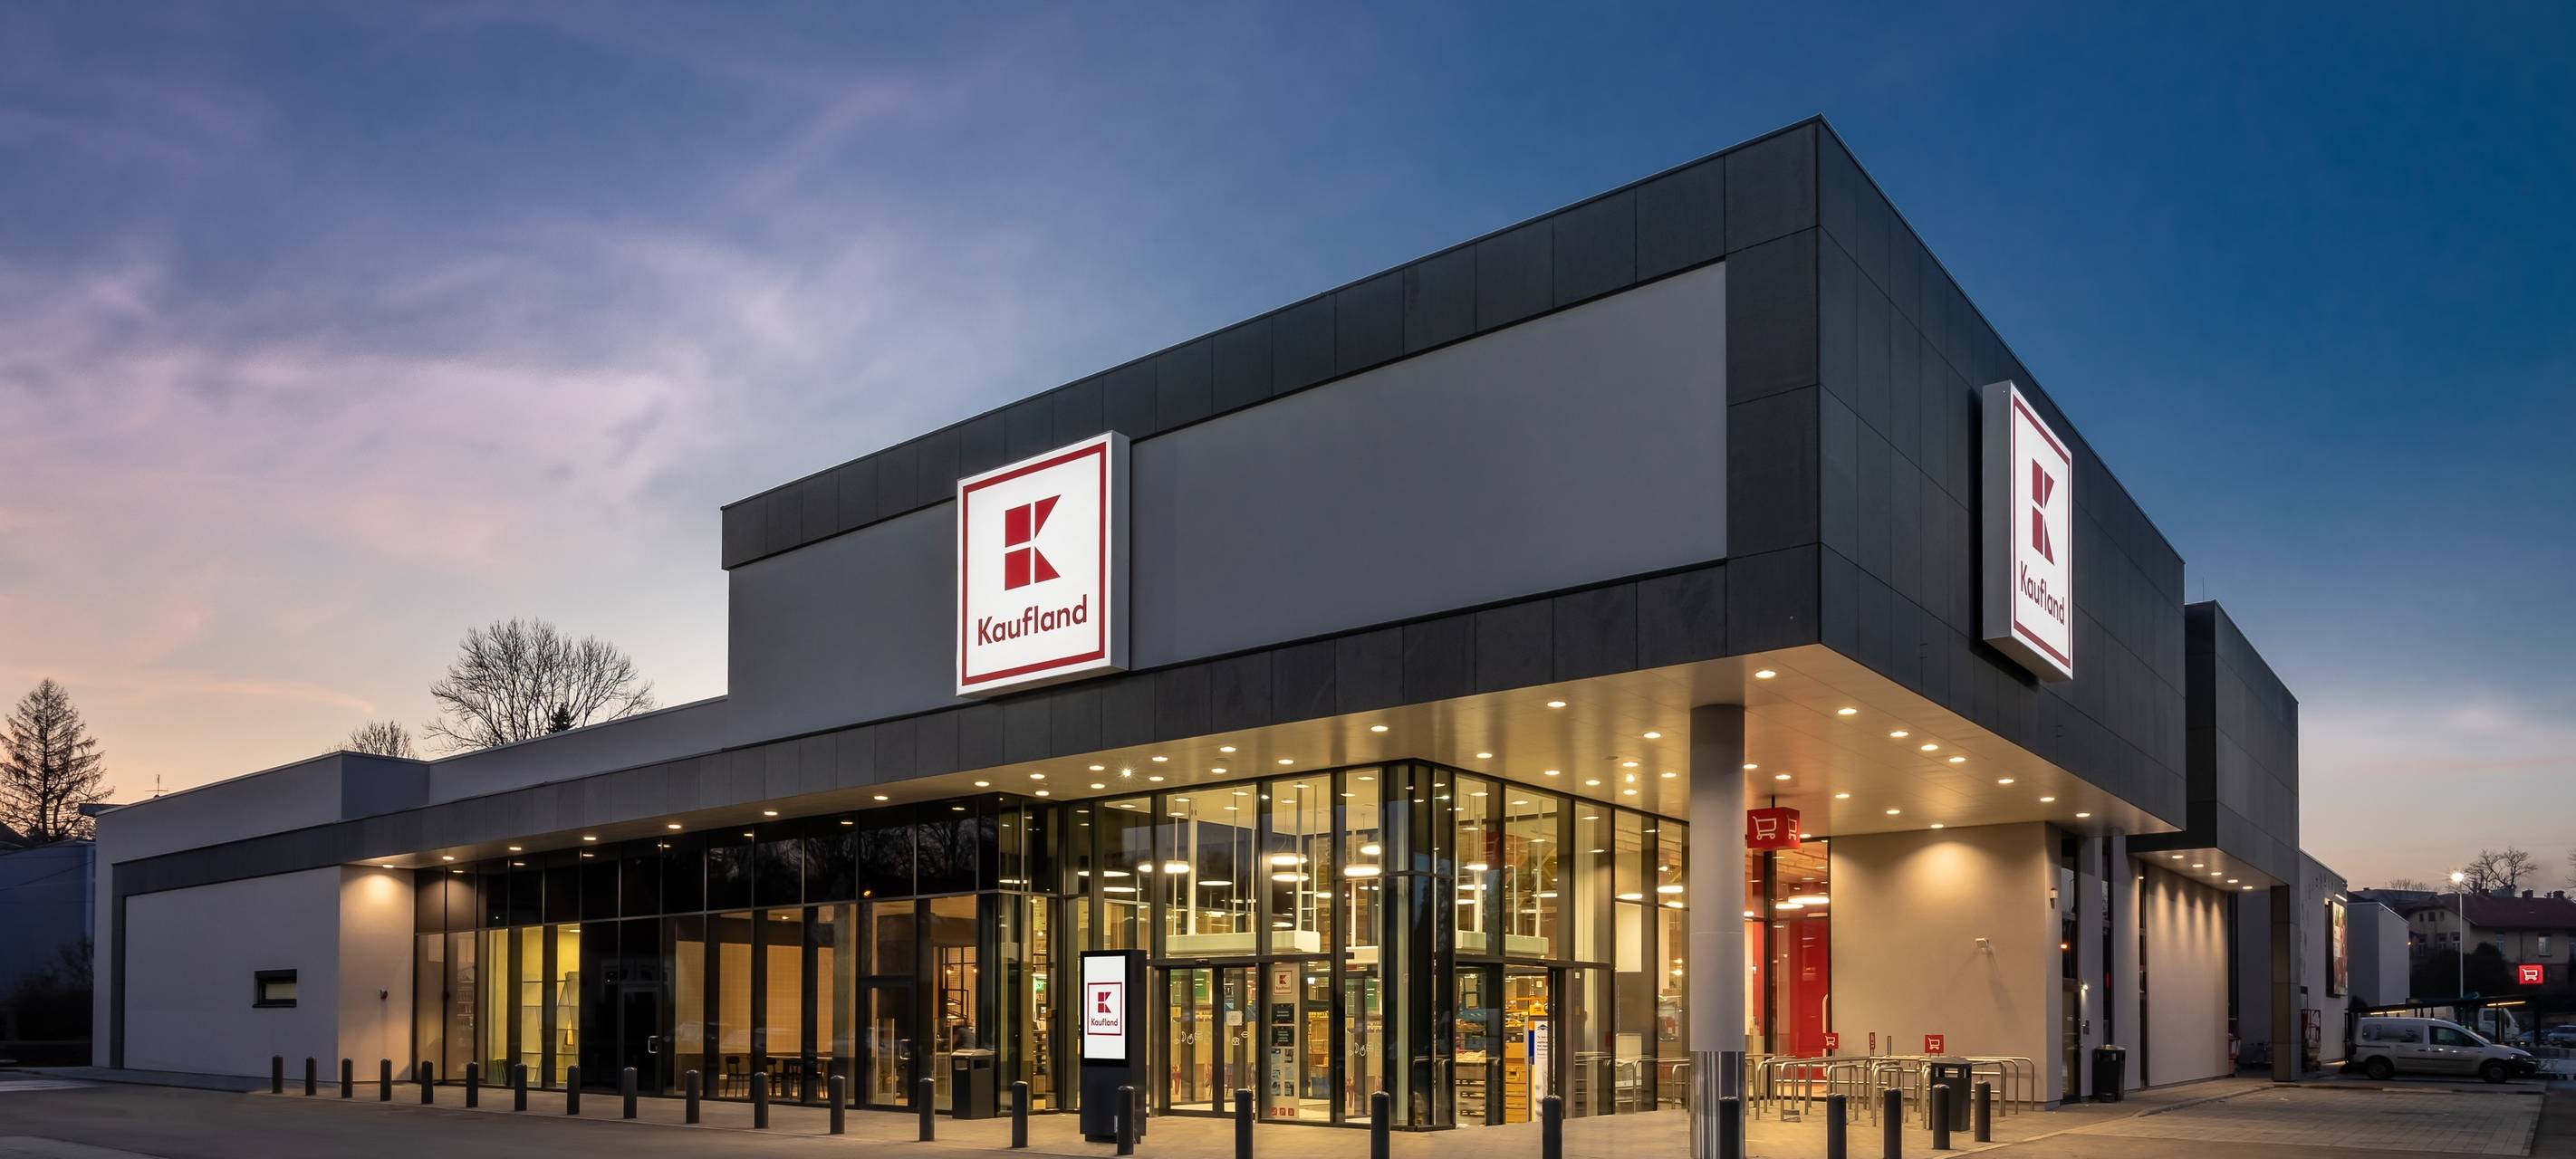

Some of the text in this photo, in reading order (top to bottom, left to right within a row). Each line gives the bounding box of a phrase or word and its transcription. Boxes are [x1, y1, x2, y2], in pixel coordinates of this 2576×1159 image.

[1004, 494, 1062, 591] K
[2033, 458, 2054, 565] K
[978, 594, 1088, 646] Kaufland
[2020, 561, 2064, 626] Kaufland
